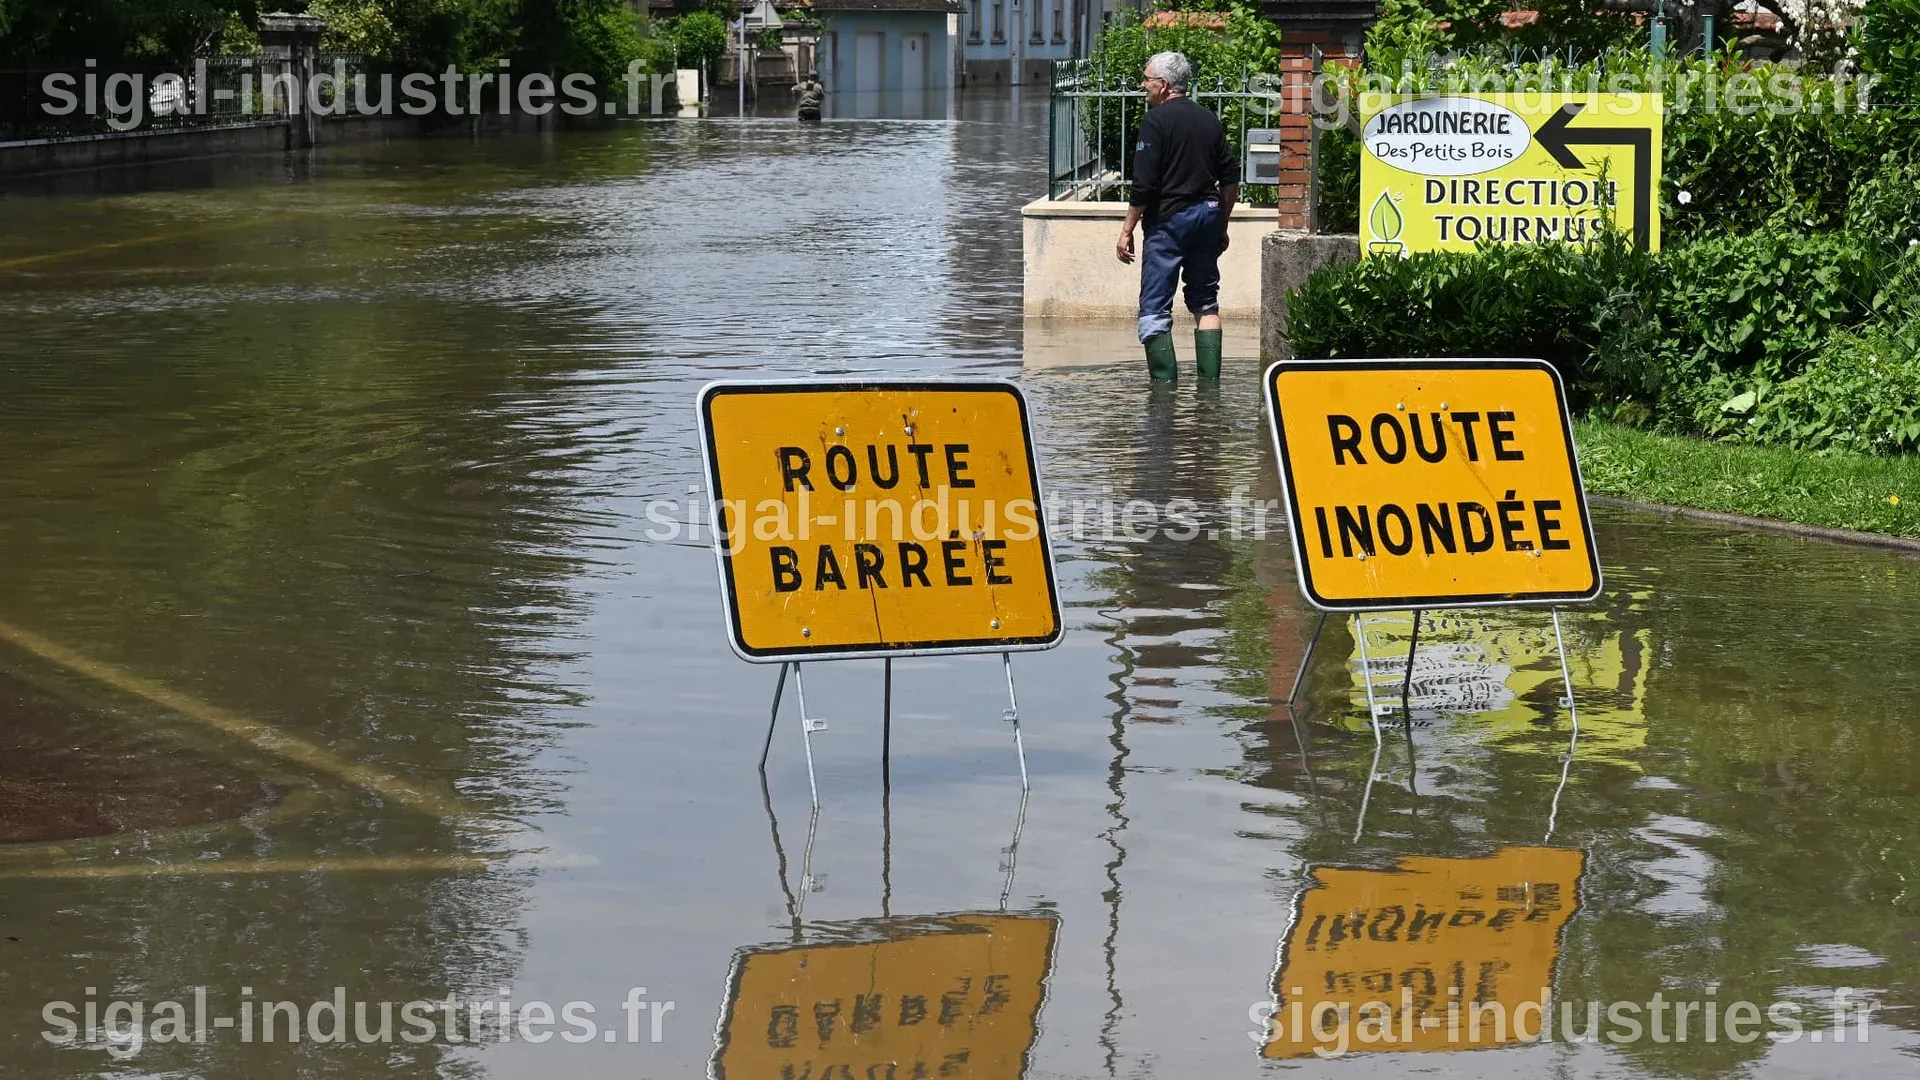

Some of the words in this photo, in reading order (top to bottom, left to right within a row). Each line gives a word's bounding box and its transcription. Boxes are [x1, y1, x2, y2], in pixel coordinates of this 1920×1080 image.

[1377, 110, 1511, 134] JARDINERIE
[1376, 142, 1408, 158] Des
[1410, 142, 1467, 163] Petits
[1471, 142, 1514, 158] Bois
[1425, 179, 1616, 206] DIRECTION
[1327, 411, 1524, 465] ROUTE
[779, 444, 976, 492] ROUTE
[1315, 490, 1571, 558] INONDÉE
[770, 529, 1013, 593] BARRÉE
